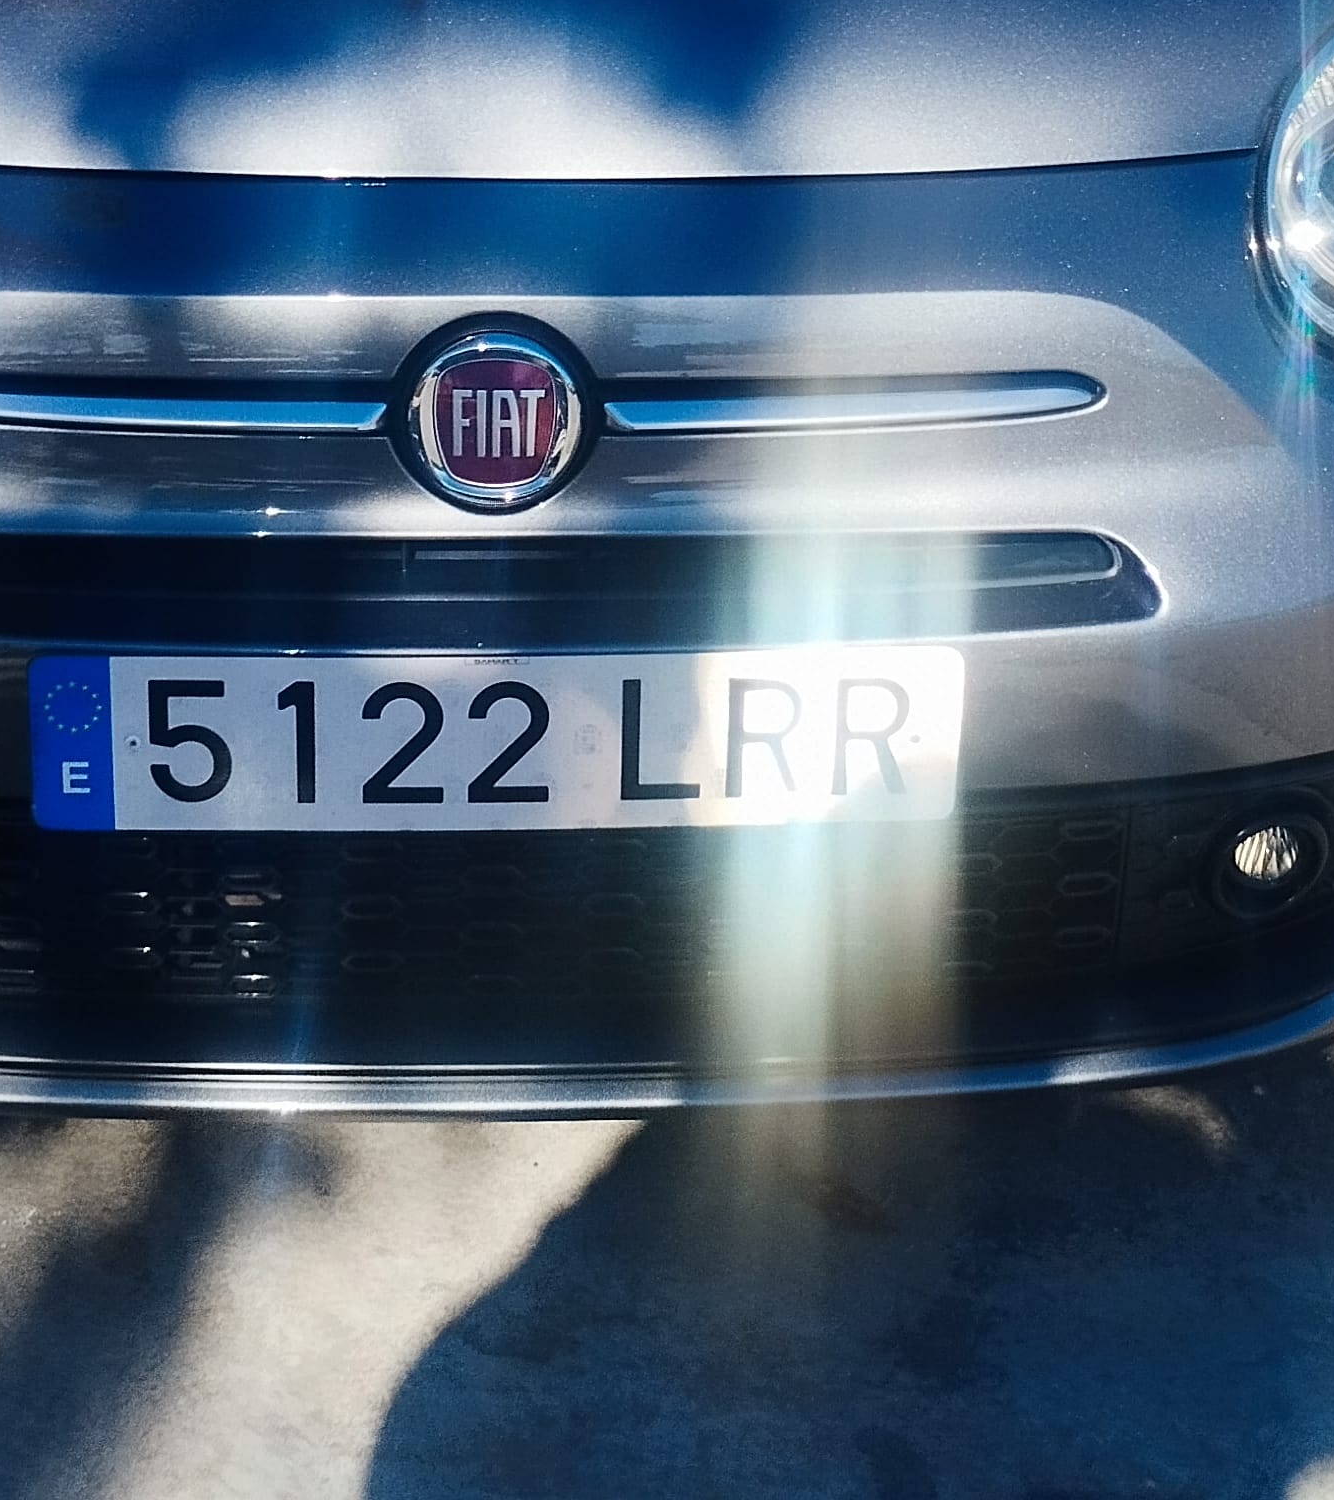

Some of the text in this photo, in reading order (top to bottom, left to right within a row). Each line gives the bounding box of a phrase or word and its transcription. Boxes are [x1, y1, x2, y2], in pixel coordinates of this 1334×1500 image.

[451, 388, 547, 458] FIAT
[147, 677, 910, 804] 5122 LRR
[61, 761, 91, 794] E
